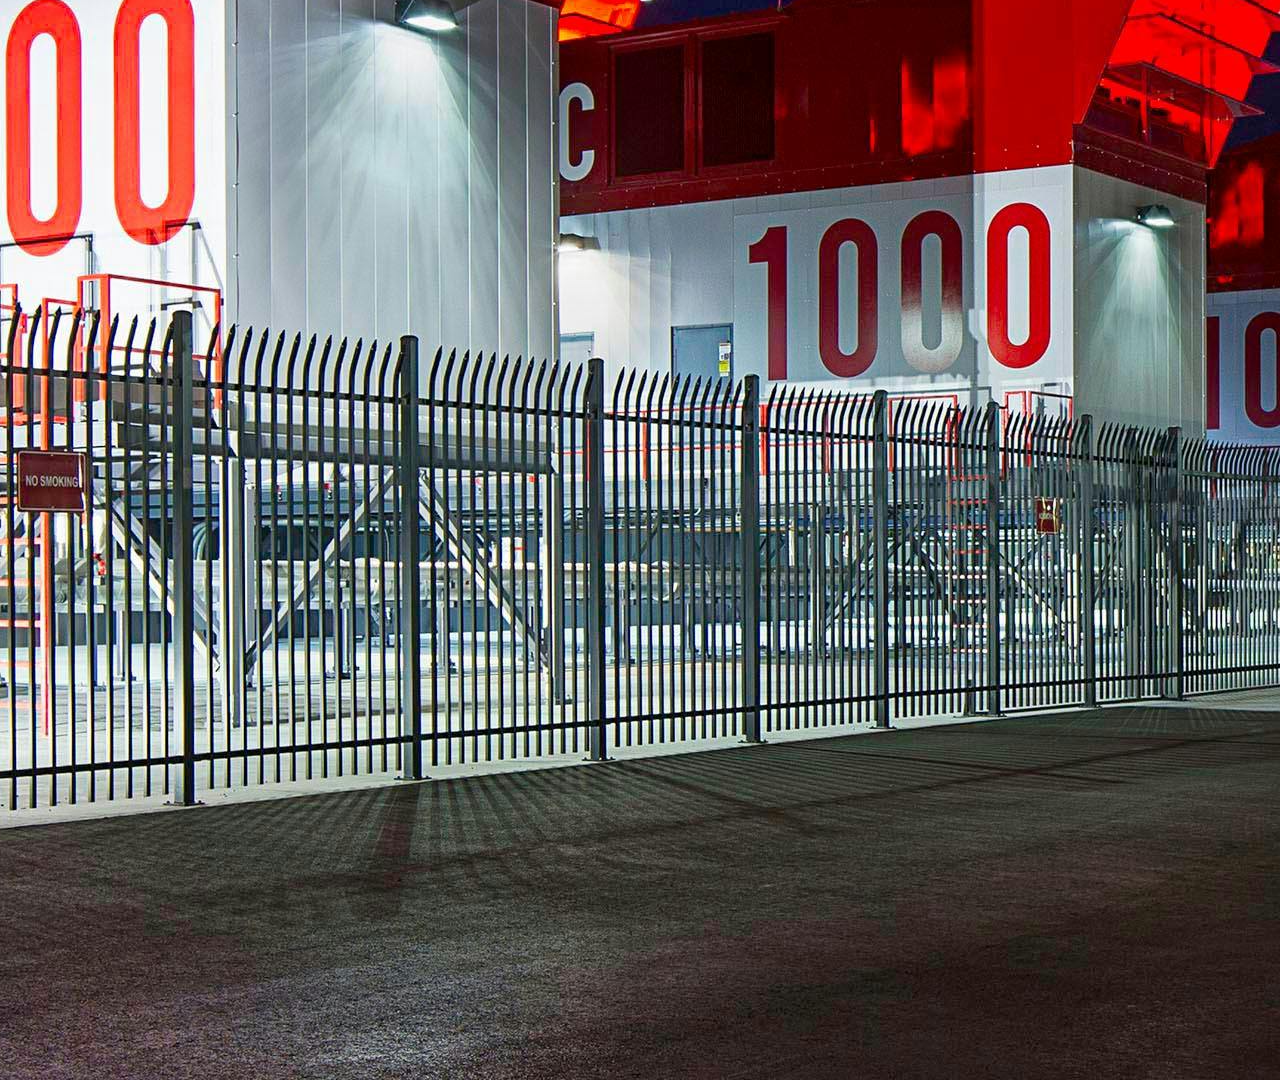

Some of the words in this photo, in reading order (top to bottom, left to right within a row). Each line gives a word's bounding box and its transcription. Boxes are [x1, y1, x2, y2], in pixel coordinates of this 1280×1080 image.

[748, 203, 1051, 381] 1000
[25, 475, 39, 487] NO
[40, 476, 79, 488] SMOKING
